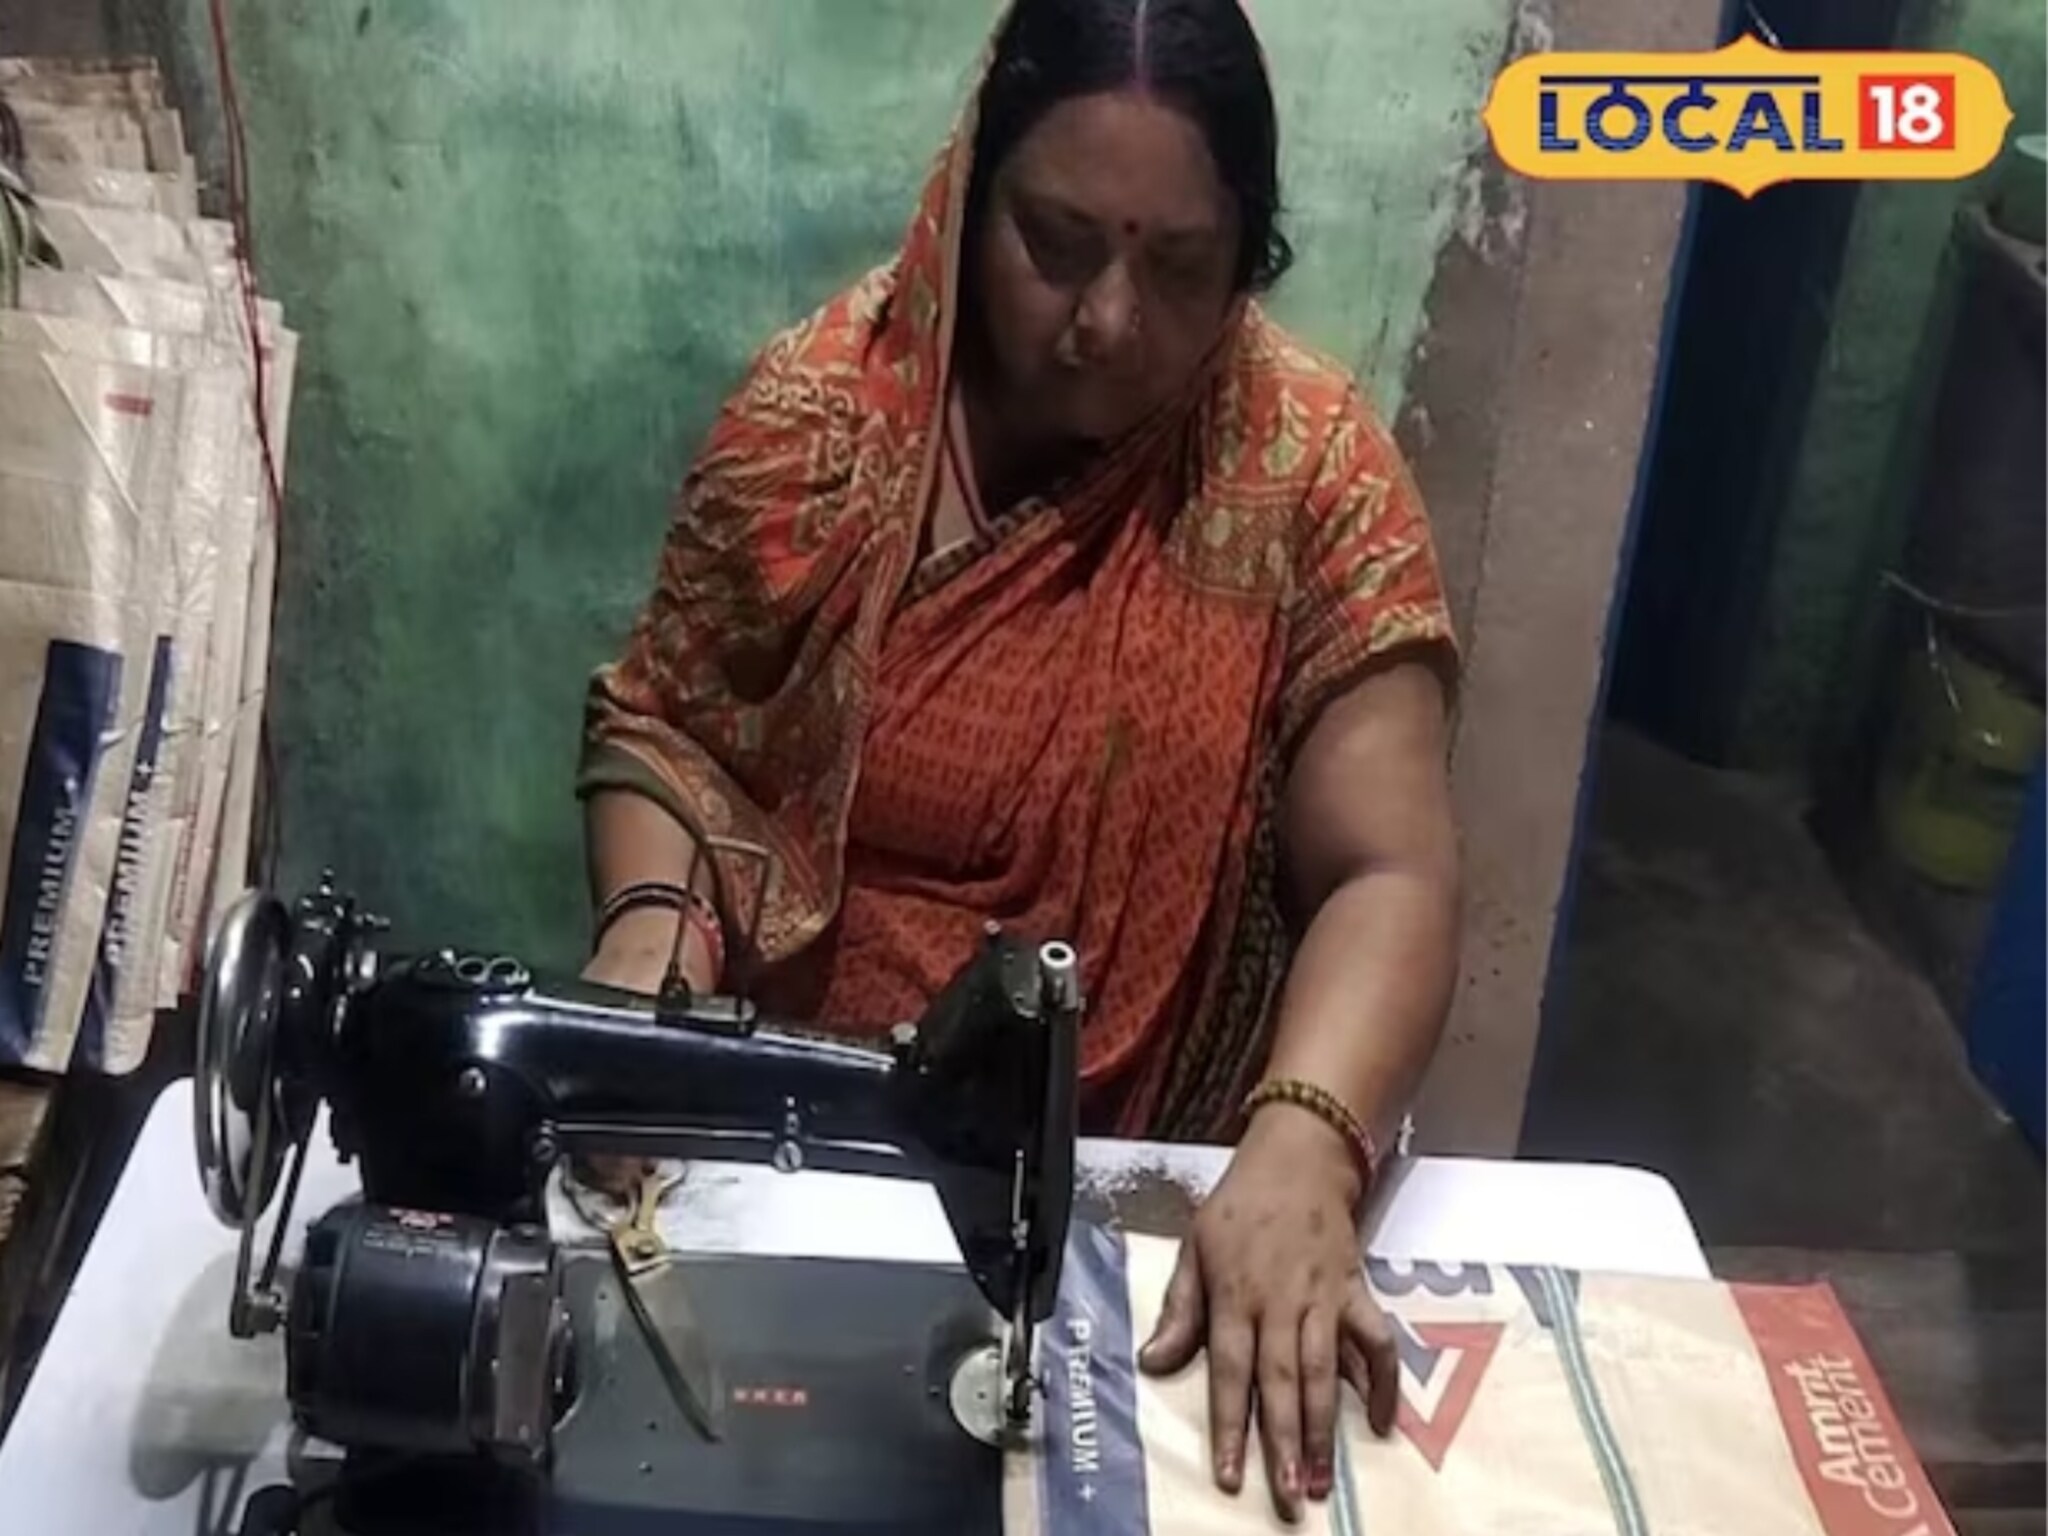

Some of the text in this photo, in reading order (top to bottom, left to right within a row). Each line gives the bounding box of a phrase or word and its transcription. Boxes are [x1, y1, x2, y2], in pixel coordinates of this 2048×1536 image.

[24, 804, 78, 985] PREMIUM
[1066, 1319, 1102, 1474] PREMIUM
[1814, 1352, 1920, 1518] Cement
